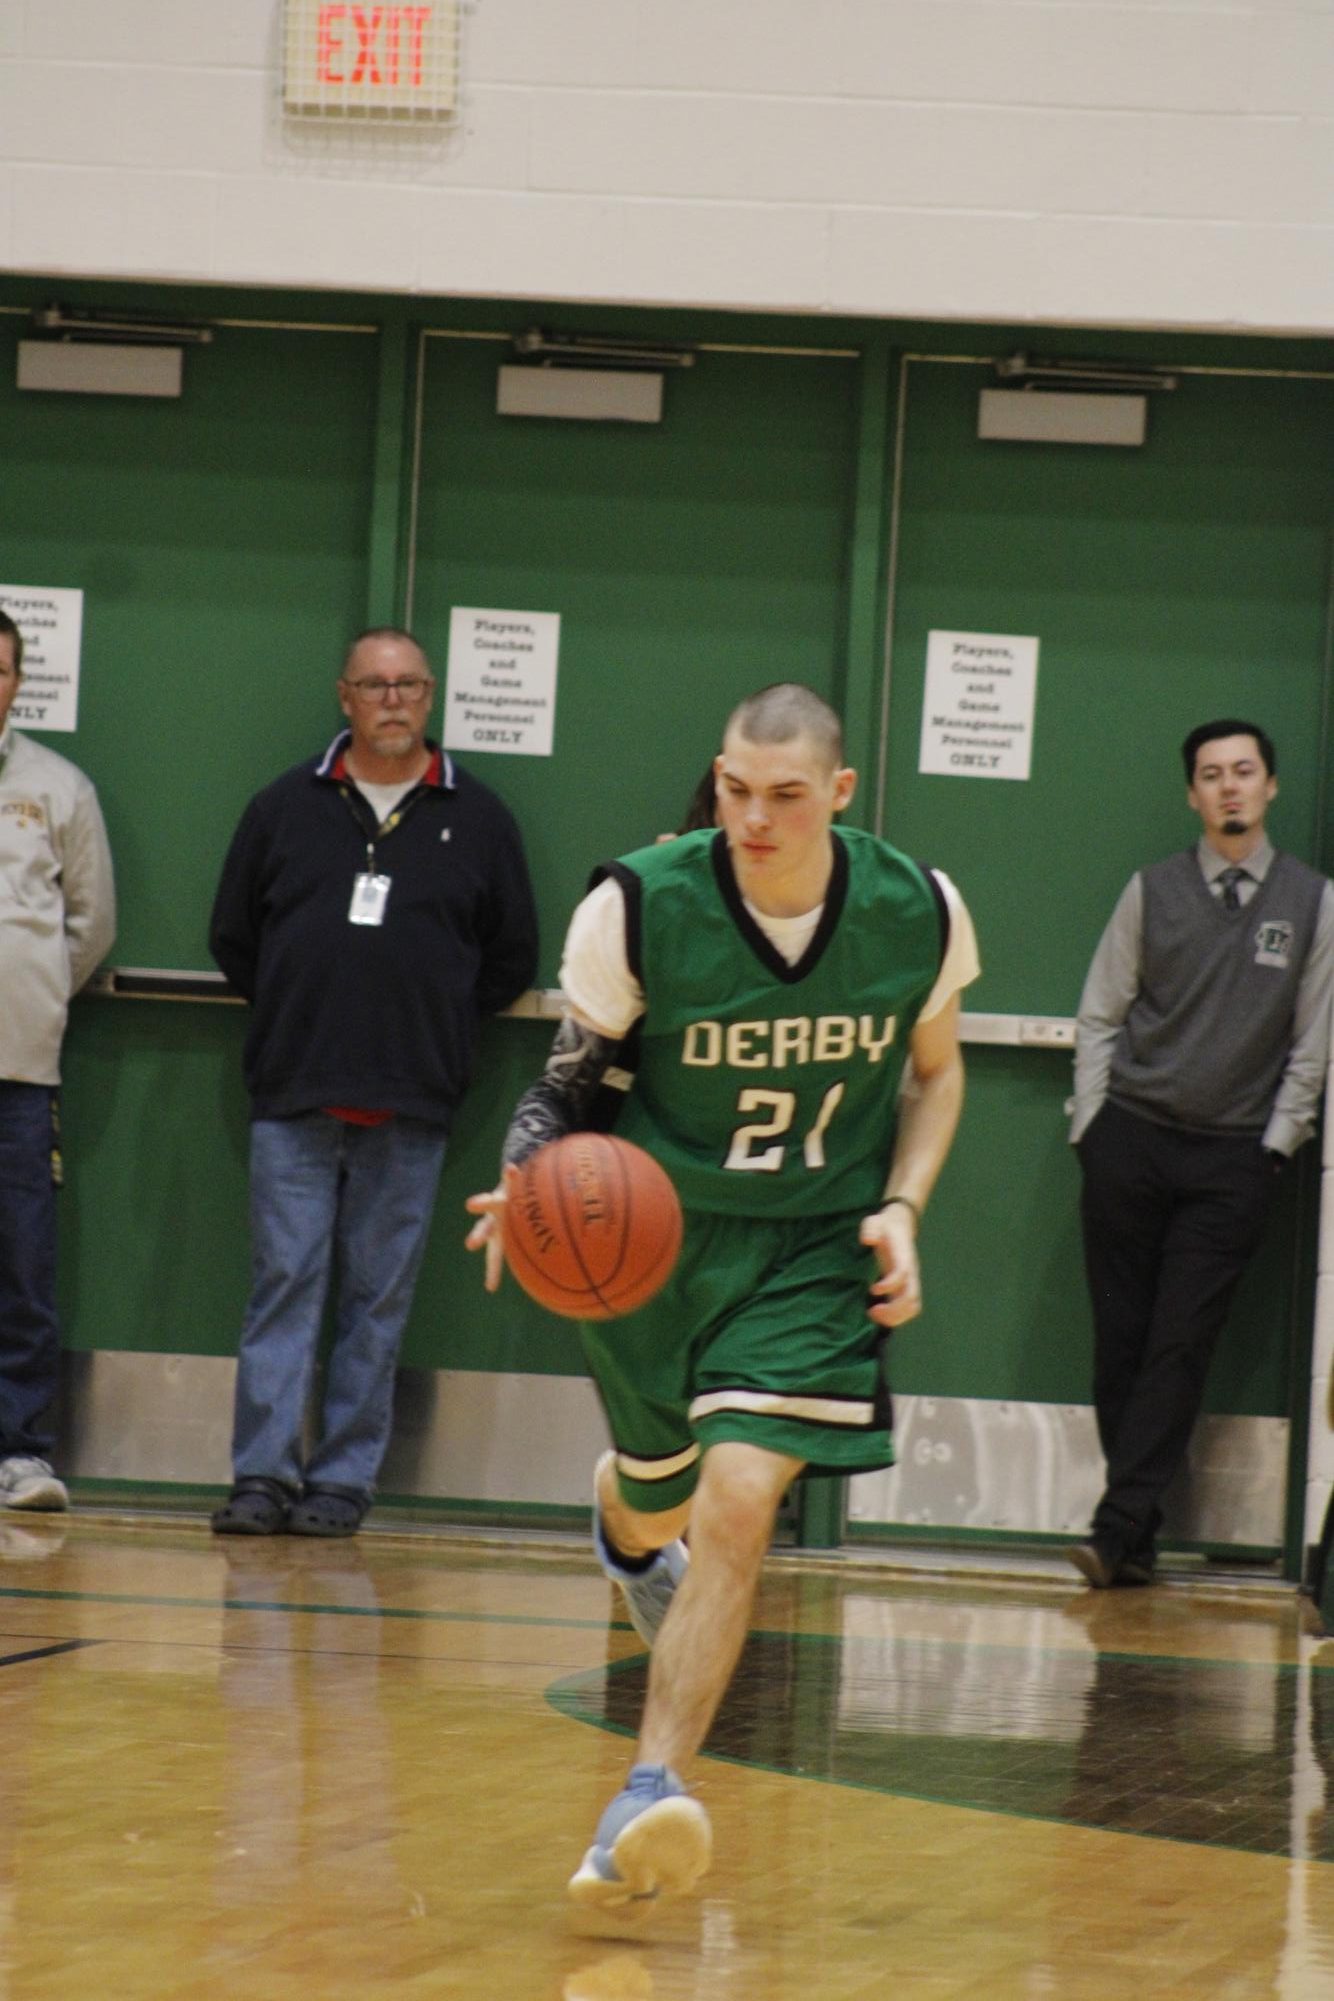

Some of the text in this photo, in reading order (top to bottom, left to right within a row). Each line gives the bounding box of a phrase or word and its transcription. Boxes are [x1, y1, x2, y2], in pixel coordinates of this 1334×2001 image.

[317, 5, 432, 86] EXIT
[16, 617, 57, 628] aches
[474, 620, 535, 635] Players,
[22, 636, 40, 646] nd
[473, 637, 534, 652] Coaches
[22, 654, 46, 664] me
[953, 644, 1014, 659] Players,
[489, 658, 516, 669] and
[952, 661, 1012, 676] Coaches
[480, 675, 522, 688] Game
[967, 683, 994, 694] and
[455, 691, 547, 707] Management
[958, 698, 1000, 712] Game
[9, 706, 47, 720] NLY
[464, 710, 535, 725] Personnel
[933, 716, 1024, 732] Management
[473, 728, 522, 744] ONLY
[942, 734, 1012, 749] Personnel
[950, 753, 1000, 768] ONLY
[681, 1014, 897, 1069] DERBY
[722, 1081, 846, 1172] 21
